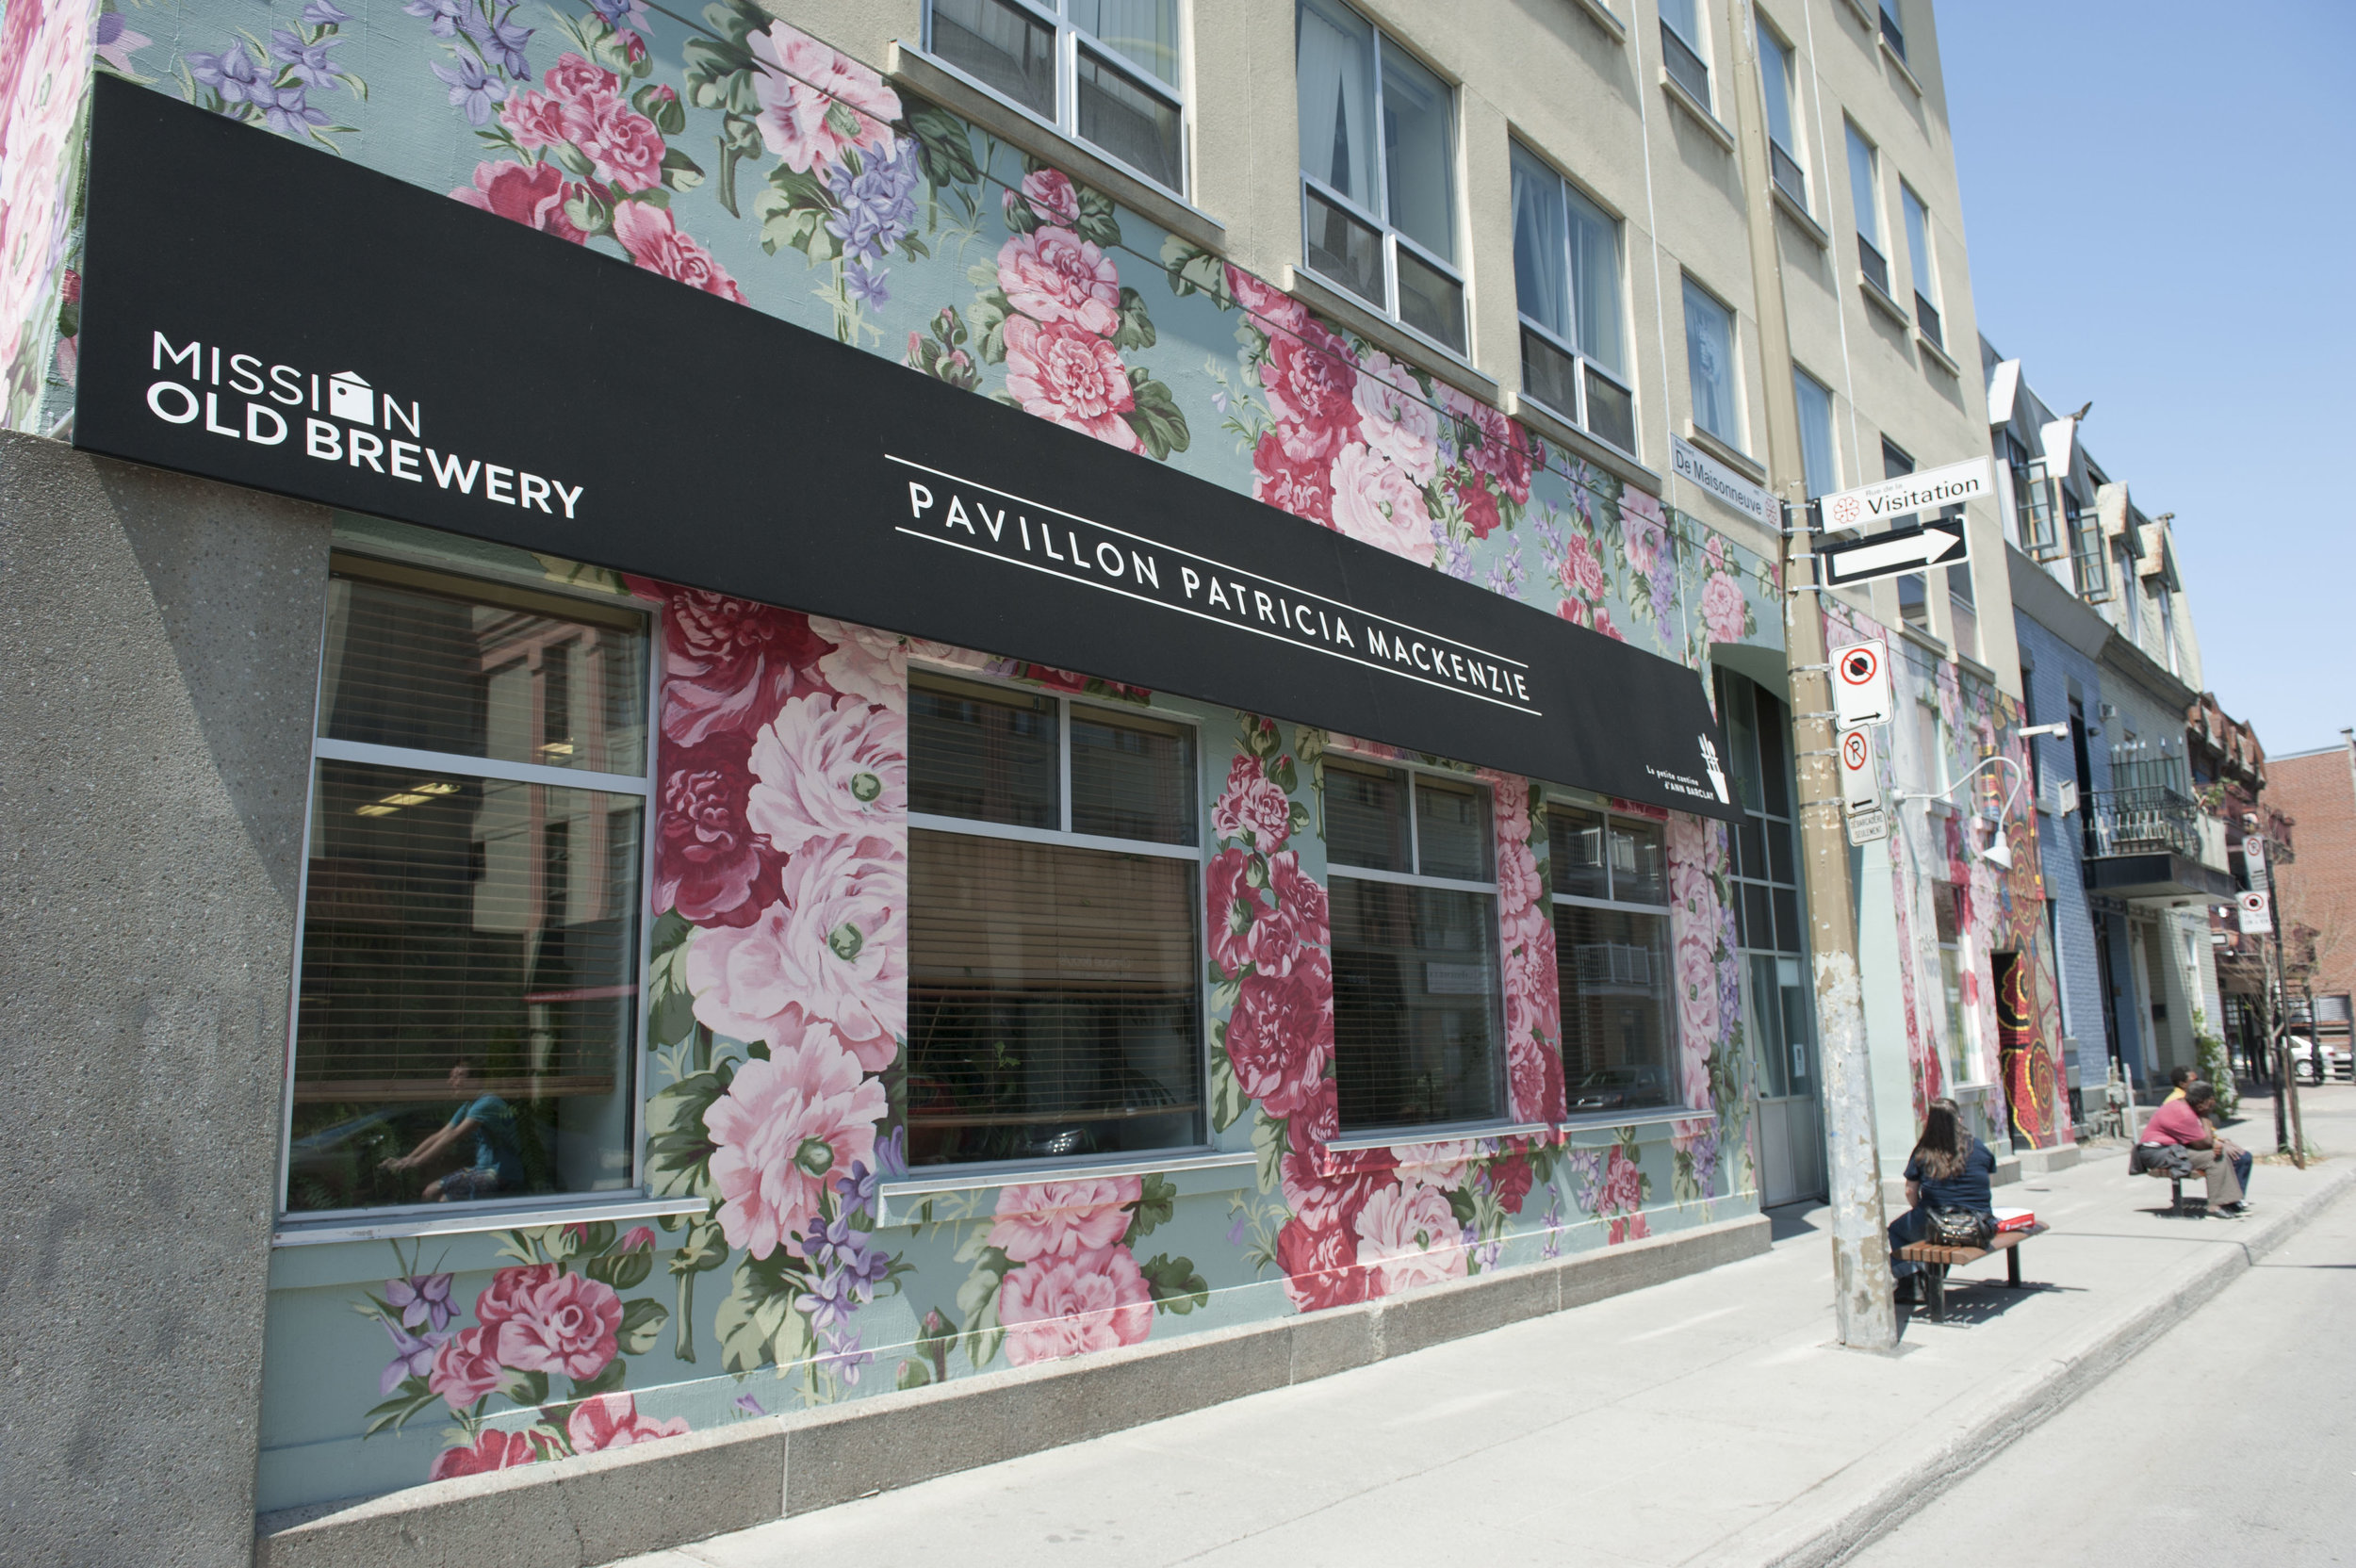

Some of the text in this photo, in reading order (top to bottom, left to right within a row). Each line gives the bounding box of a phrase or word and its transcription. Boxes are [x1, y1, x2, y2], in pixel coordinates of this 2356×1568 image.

[146, 381, 584, 519] OLD BREWERY
[1676, 449, 1762, 515] De Maisonneuve
[1865, 482, 1904, 497] Rue de la
[1868, 478, 1980, 514] Visitation
[908, 481, 1530, 701] PAVILLON PATRICIA MACKENZIE
[1645, 764, 1655, 775] La
[1656, 769, 1676, 779] petite
[1686, 785, 1714, 801] BARCLAY
